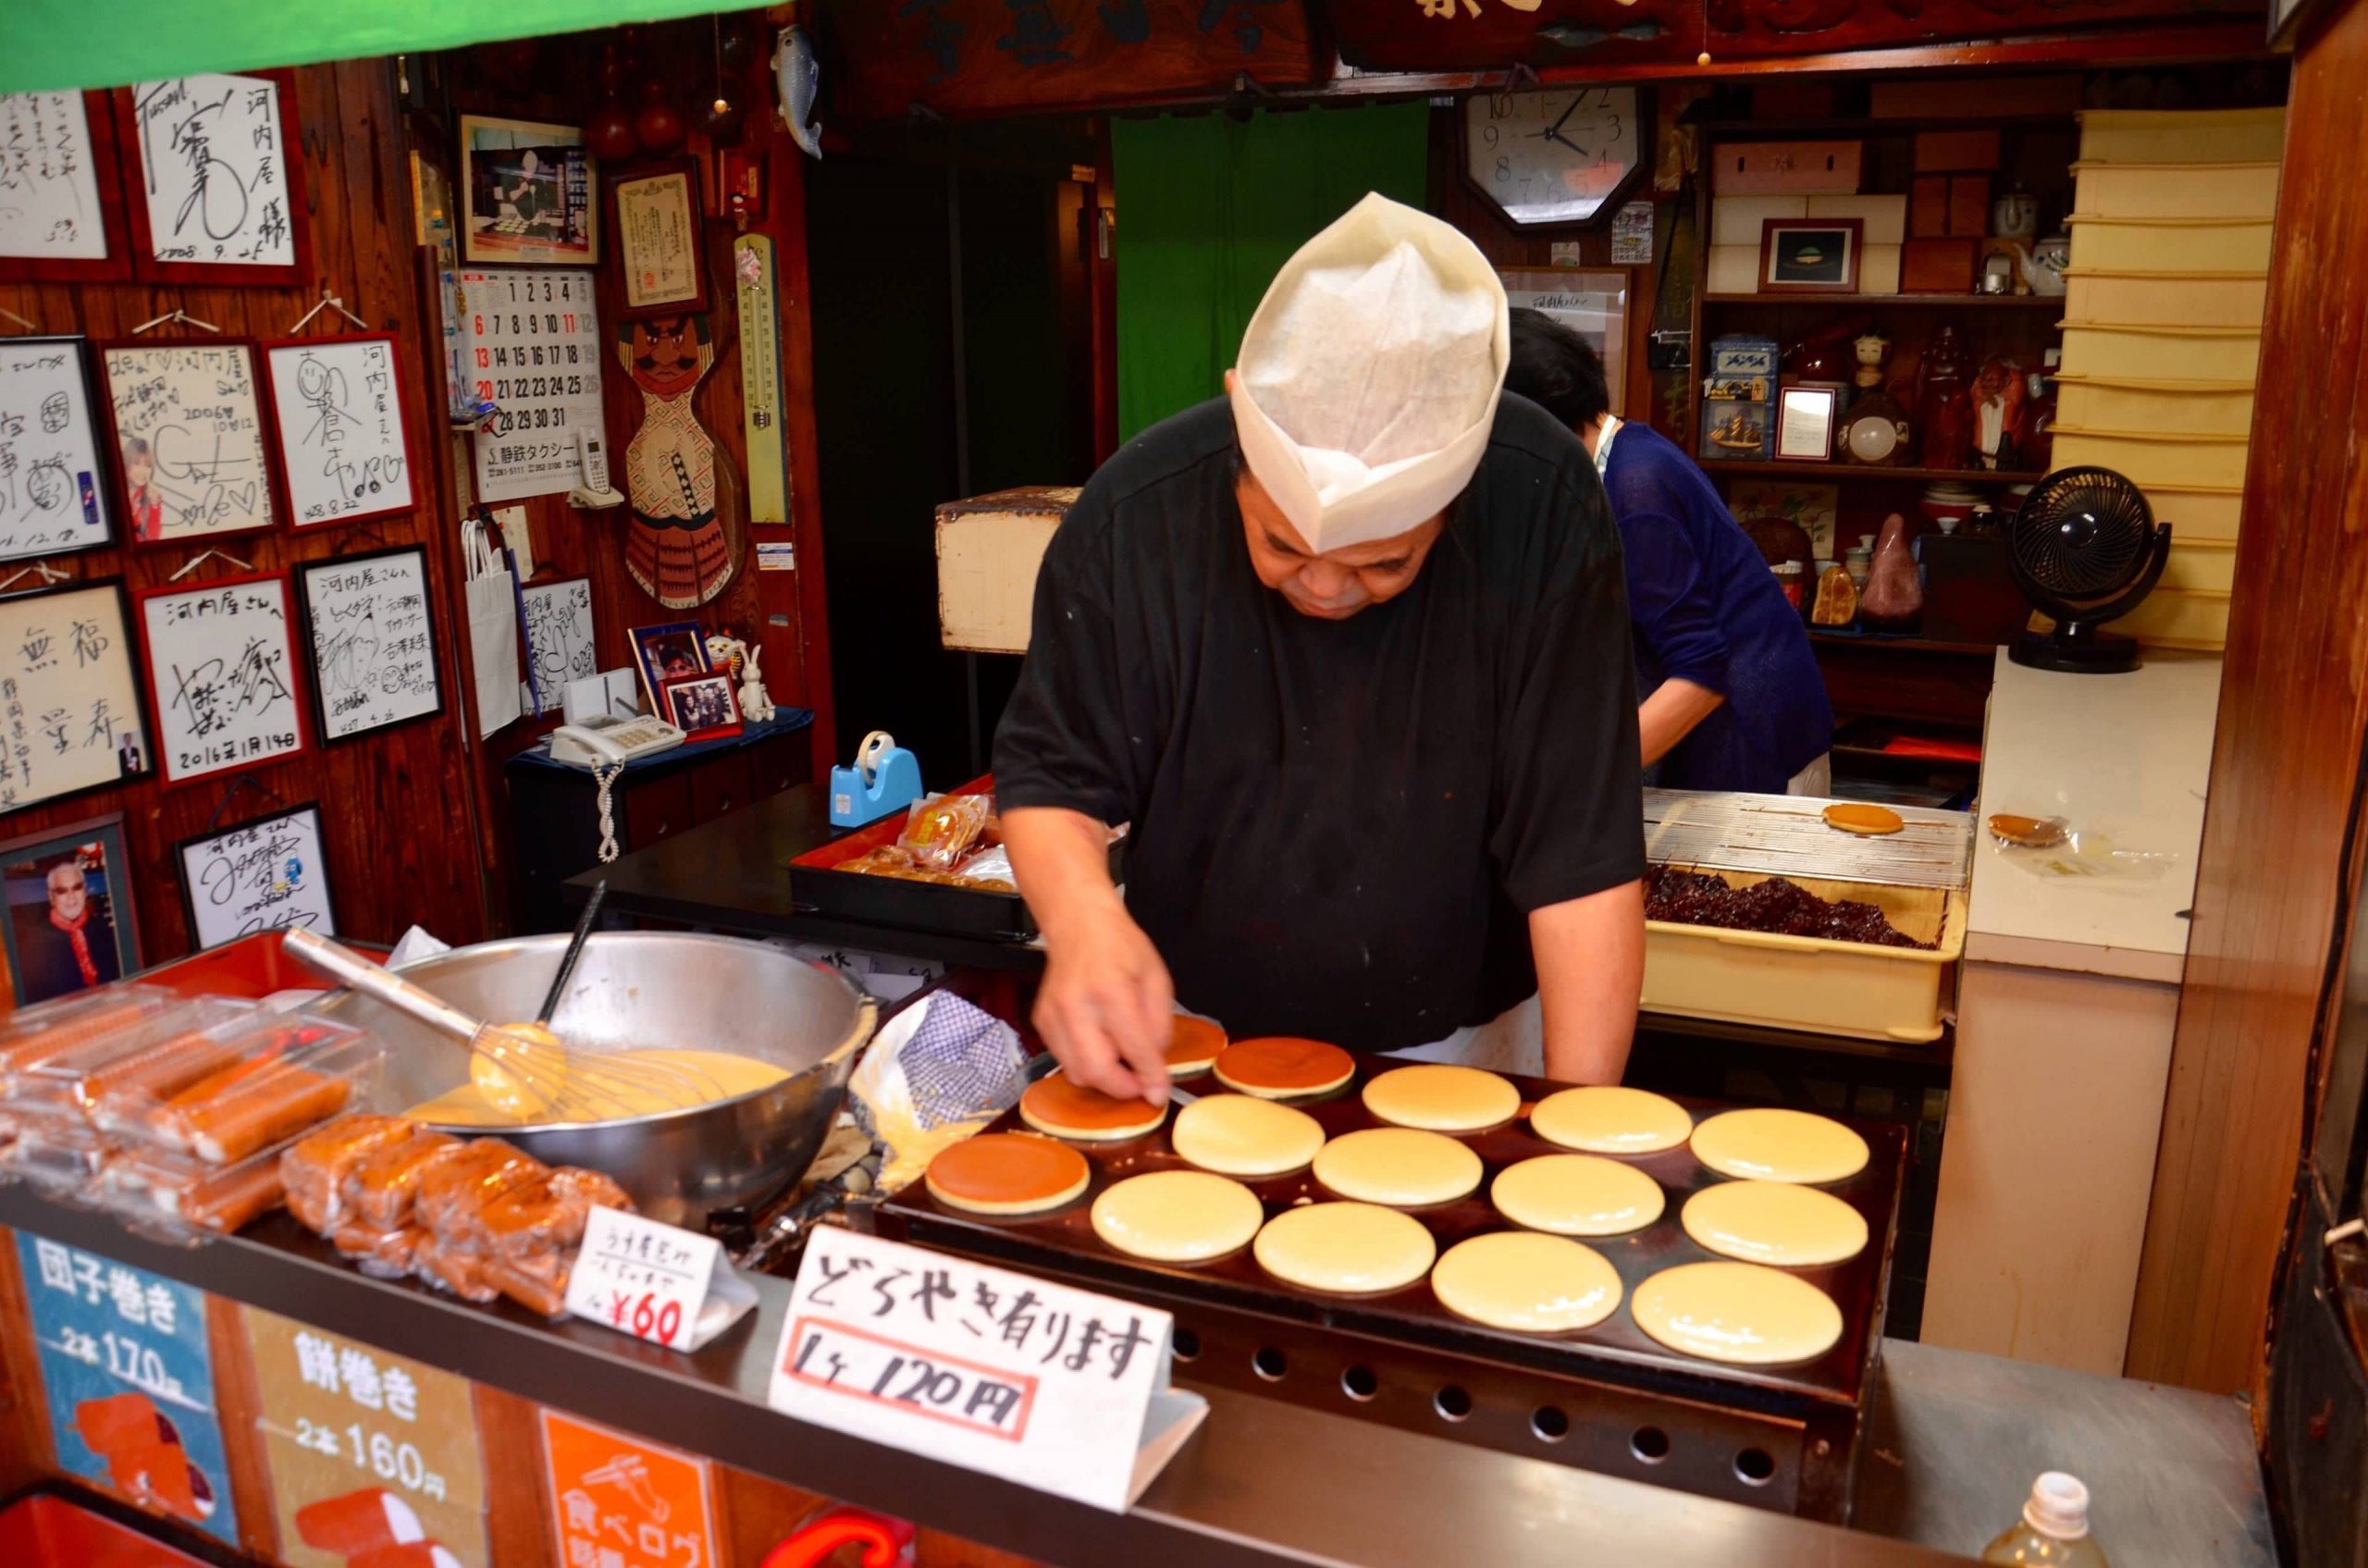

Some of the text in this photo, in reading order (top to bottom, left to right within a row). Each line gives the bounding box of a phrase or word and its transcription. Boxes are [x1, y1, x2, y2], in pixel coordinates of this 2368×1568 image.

[1483, 114, 1622, 151] 9 3
[1495, 155, 1511, 182] 8
[509, 282, 516, 302] 1
[527, 282, 535, 302] 2
[544, 282, 552, 302] 3
[561, 282, 570, 302] 4
[475, 315, 484, 335] 6
[493, 315, 500, 334] 7
[512, 315, 520, 334] 8
[529, 314, 537, 334] 9
[545, 314, 558, 334] 10
[562, 314, 575, 333] 11
[475, 348, 488, 368] 13
[494, 347, 507, 367] 14
[512, 346, 525, 366] 15
[531, 346, 544, 365] 16
[549, 345, 560, 364] 17
[565, 345, 578, 364] 18
[477, 380, 492, 400] 20
[497, 379, 511, 400] 21
[514, 378, 529, 398] 22
[532, 377, 547, 397] 23
[549, 377, 563, 396] 24
[567, 376, 581, 394] 25
[500, 411, 513, 431] 28
[517, 410, 531, 429] 29
[535, 408, 549, 428] 30
[552, 407, 565, 426] 31
[500, 442, 574, 463] 静鉄タクシー
[319, 567, 410, 599] 河内屋さんへ
[166, 590, 284, 626] 河内屋さんへ
[34, 1236, 177, 1335] 団子巻き
[607, 1289, 682, 1347] ¥60
[807, 1255, 1153, 1379] どらやき有ります
[871, 1356, 1022, 1426] 120円
